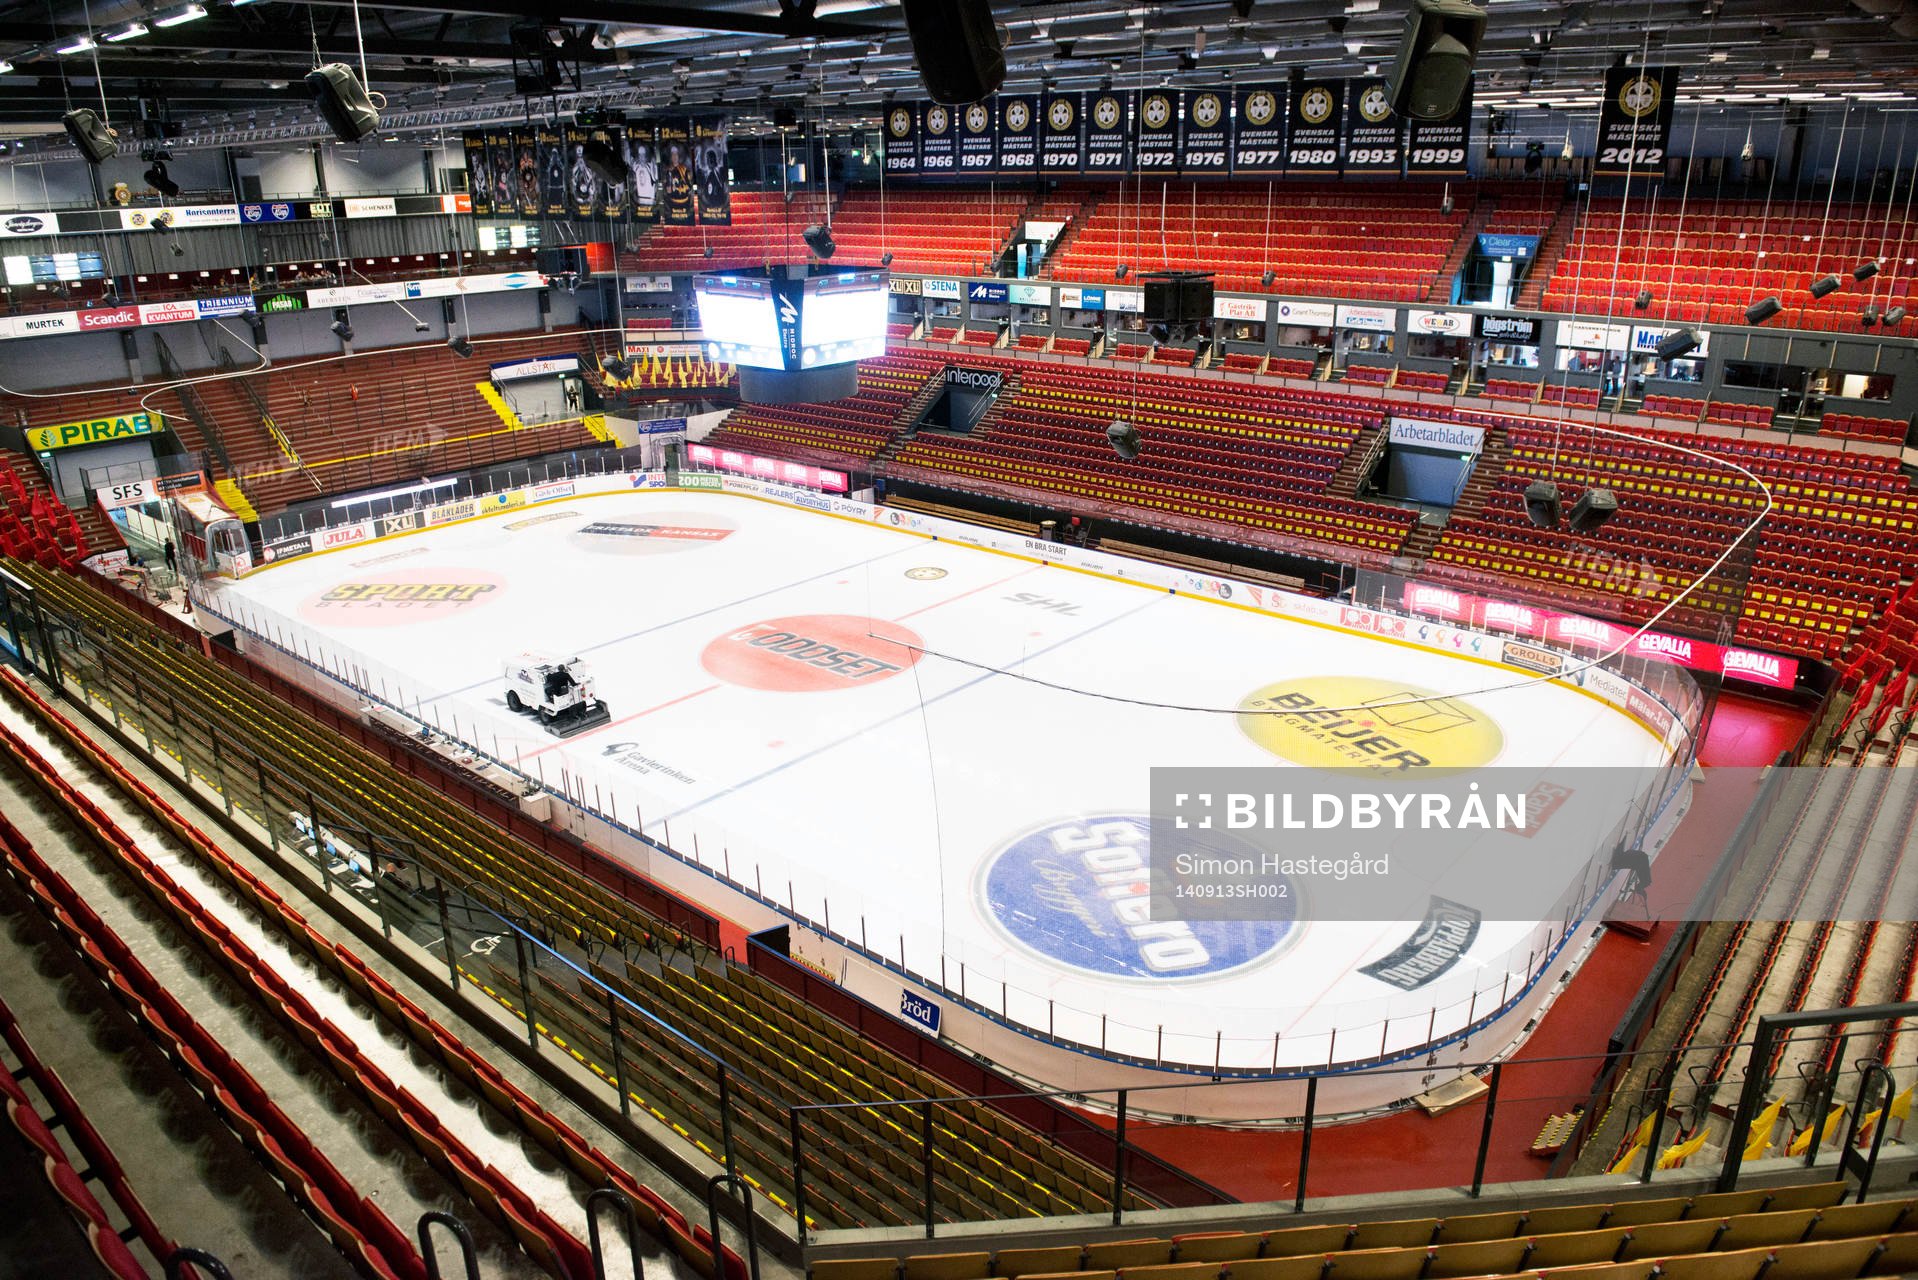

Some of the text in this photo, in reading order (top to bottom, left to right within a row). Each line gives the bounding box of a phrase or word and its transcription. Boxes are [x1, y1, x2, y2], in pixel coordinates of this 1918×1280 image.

[1240, 130, 1279, 138] SVENSKA
[1294, 128, 1335, 137] SVENSKA
[1353, 127, 1396, 136] SVENSKA
[1417, 126, 1463, 135] SVENSKA
[1608, 123, 1662, 132] SVENSKA
[963, 136, 991, 144] SVENSKA
[1003, 135, 1033, 143] SVENSKA
[1045, 134, 1076, 142] SVENSKA
[1090, 133, 1122, 142] SVENSKA
[1138, 132, 1174, 141] SVENSKA
[1188, 132, 1224, 140] SVENSKA
[923, 155, 953, 168] 1966
[961, 154, 993, 167] 1967
[1000, 153, 1034, 167] 1968
[1042, 153, 1078, 167] 1970
[1089, 152, 1122, 166] 1971
[1136, 152, 1175, 166] 1972
[1185, 151, 1226, 166] 1976
[1236, 150, 1280, 165] 1977
[1289, 149, 1337, 164] 1980
[1349, 149, 1398, 164] 1993
[1411, 148, 1465, 164] 1999
[1600, 147, 1664, 164] 2012
[887, 157, 916, 169] 1964
[361, 204, 394, 212] SCHENKER
[931, 281, 957, 292] STENA
[163, 303, 177, 311] ICA
[200, 296, 253, 308] TRIENNIUM
[25, 318, 65, 330] MURTEK
[84, 311, 135, 326] Scandic
[148, 311, 194, 323] KVANTUM
[60, 415, 153, 445] PIRAB
[1395, 423, 1475, 448] Arbetarbladet
[112, 484, 143, 500] SFS
[765, 487, 793, 500] REJLERS
[326, 526, 364, 546] JULA
[1025, 540, 1067, 556] EN BRA START
[320, 583, 497, 602] SPORT
[1004, 592, 1082, 616] SHL
[1560, 618, 1610, 642] GEVALIA
[1639, 634, 1692, 659] GEVALIA
[749, 631, 904, 680] ODDSET
[1510, 647, 1556, 668] GROLLS
[1724, 651, 1780, 678] GEVALIA
[1269, 692, 1431, 772] BEIJER
[614, 755, 651, 775] Arena
[626, 749, 697, 785] Gavlerinken
